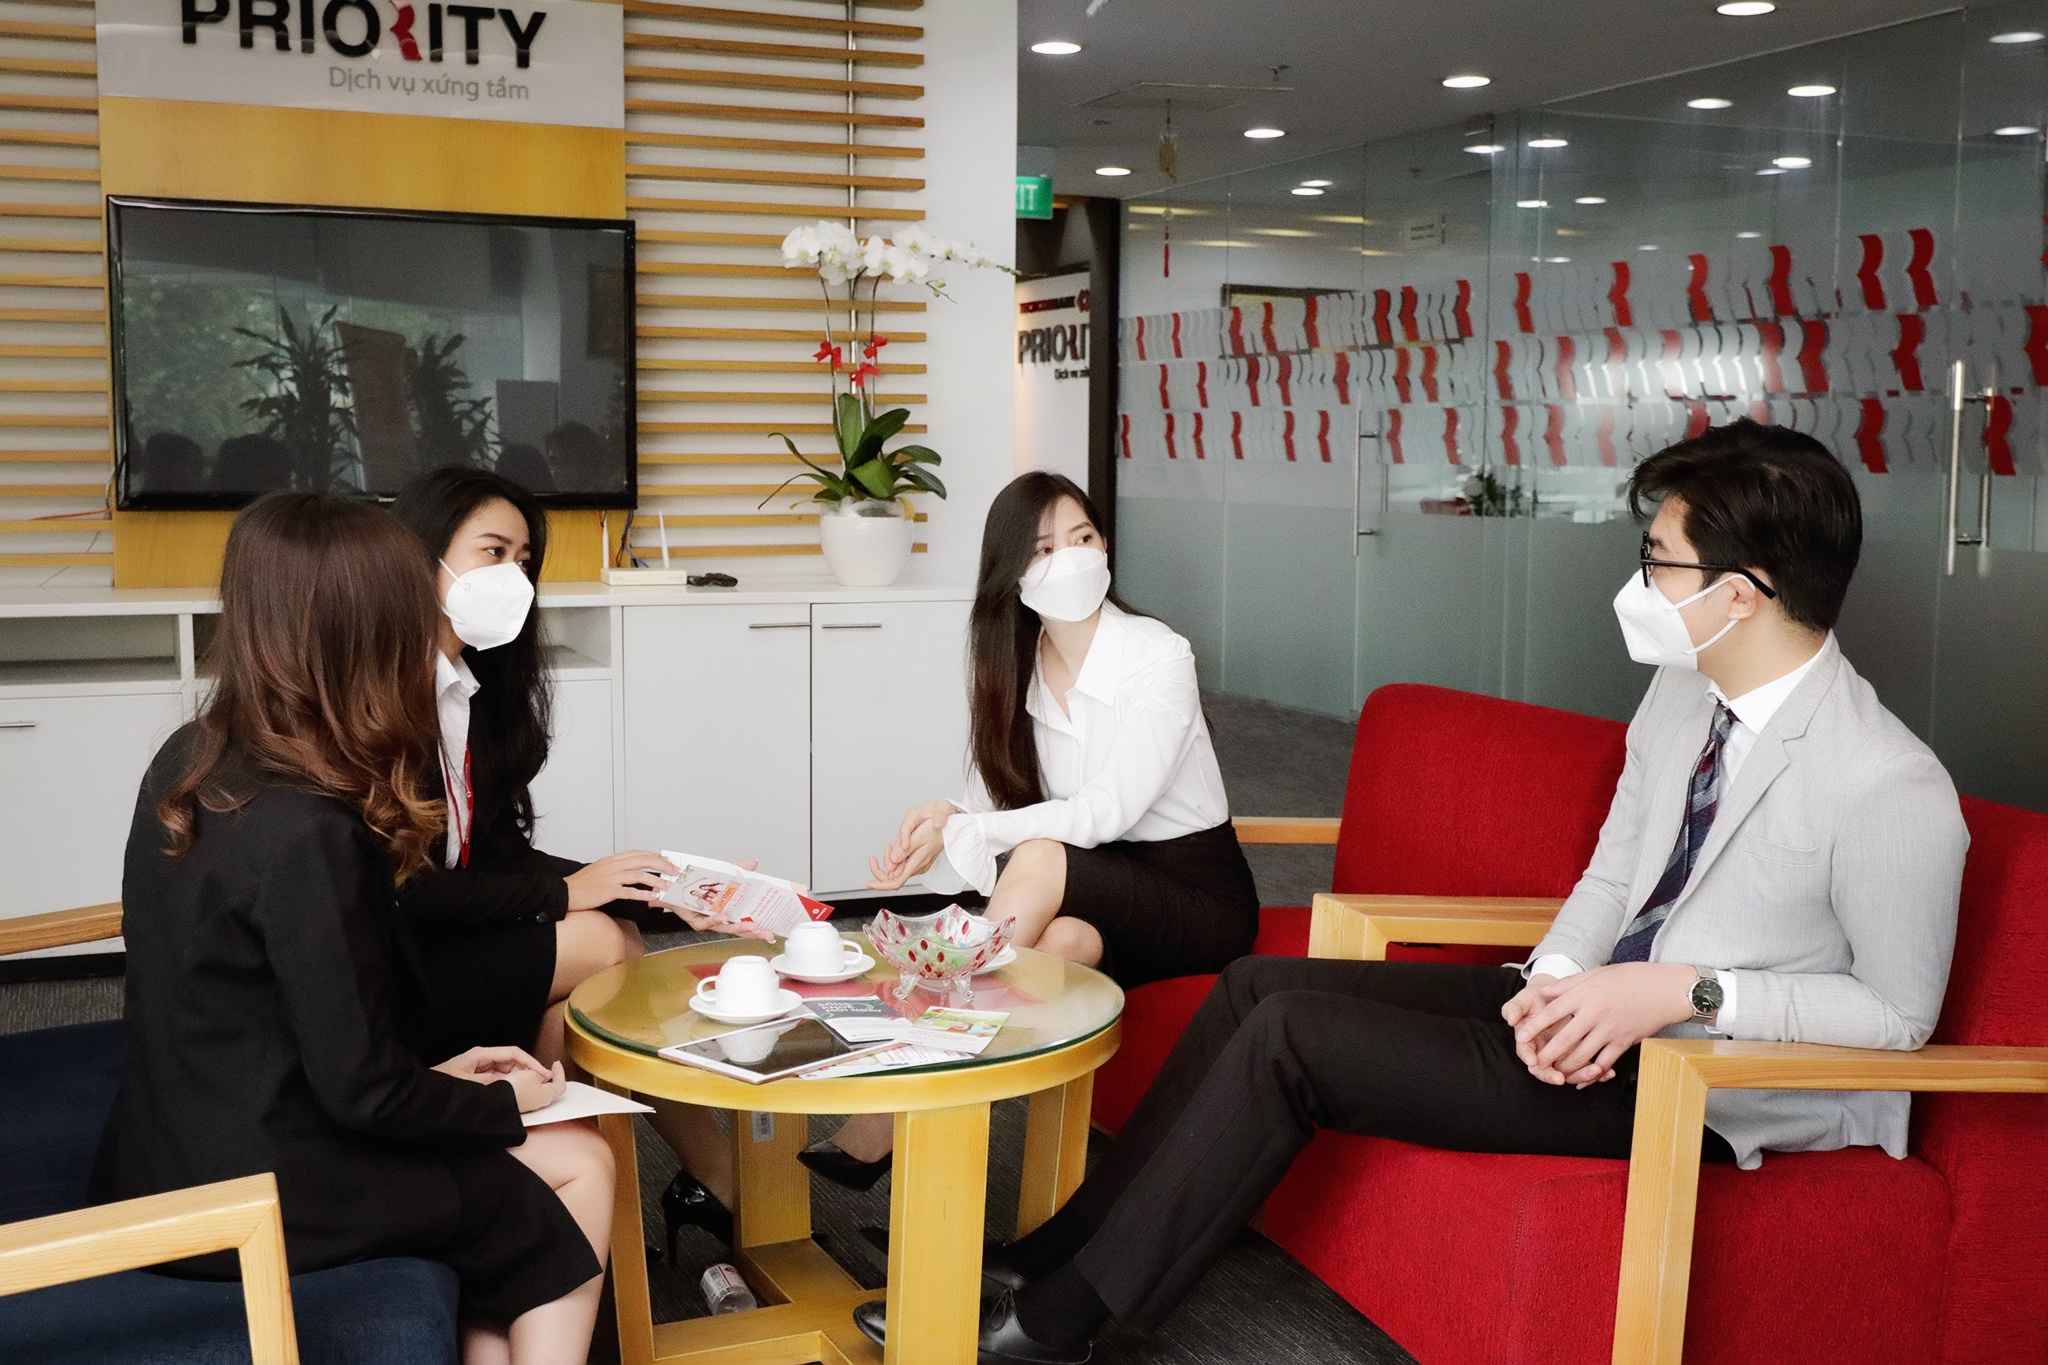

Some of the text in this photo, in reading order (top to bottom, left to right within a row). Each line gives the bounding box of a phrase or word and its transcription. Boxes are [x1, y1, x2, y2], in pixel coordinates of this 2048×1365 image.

[182, 0, 547, 68] PRIORITY
[329, 67, 529, 101] Dịch vụ xứng tầm
[1016, 184, 1038, 211] IT
